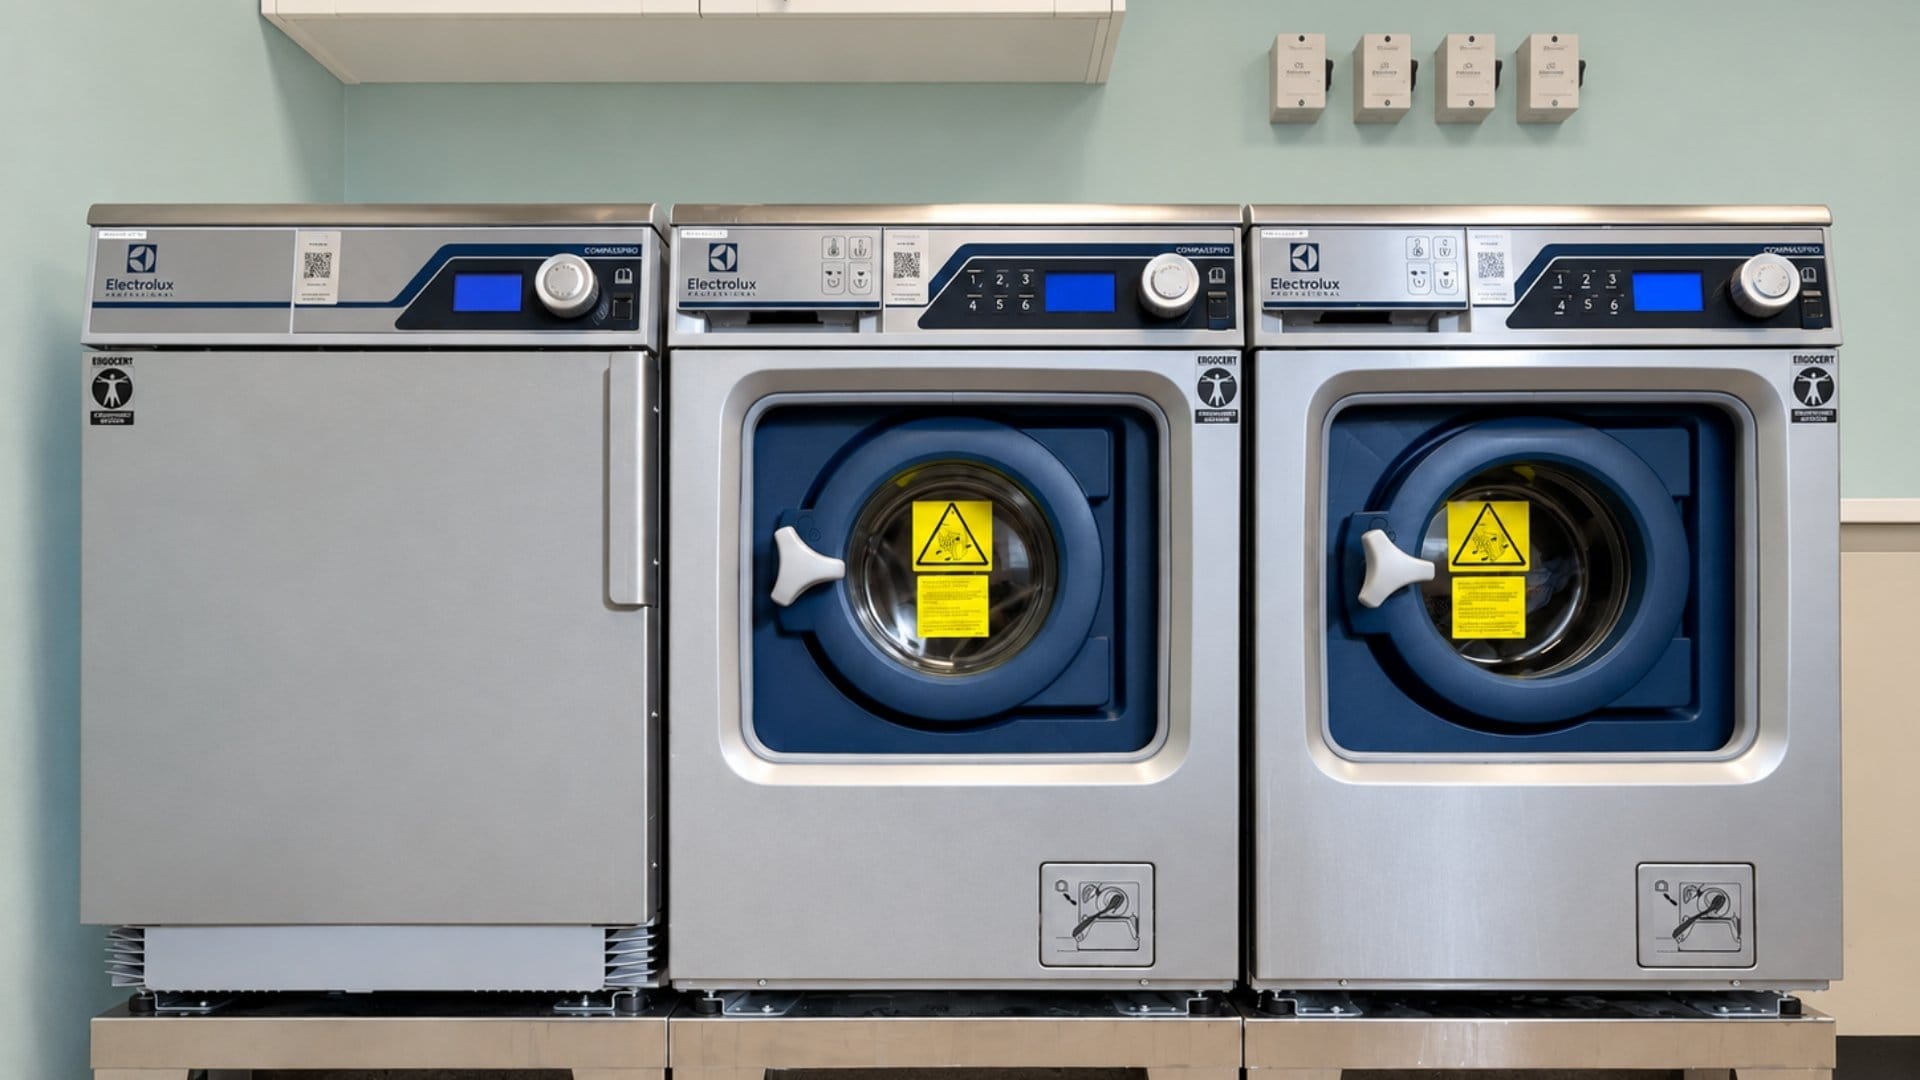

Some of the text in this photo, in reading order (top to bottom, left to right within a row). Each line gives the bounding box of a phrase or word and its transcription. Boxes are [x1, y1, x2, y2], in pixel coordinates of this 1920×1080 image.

[106, 278, 173, 291] Electrolux
[688, 278, 756, 290] Electrolux
[971, 274, 1030, 285] 1 2 3
[1271, 278, 1340, 290] Electrolux
[1557, 274, 1617, 285] 1 2 3
[969, 299, 1030, 311] 4 5 6
[1557, 299, 1619, 310] 4 5 6
